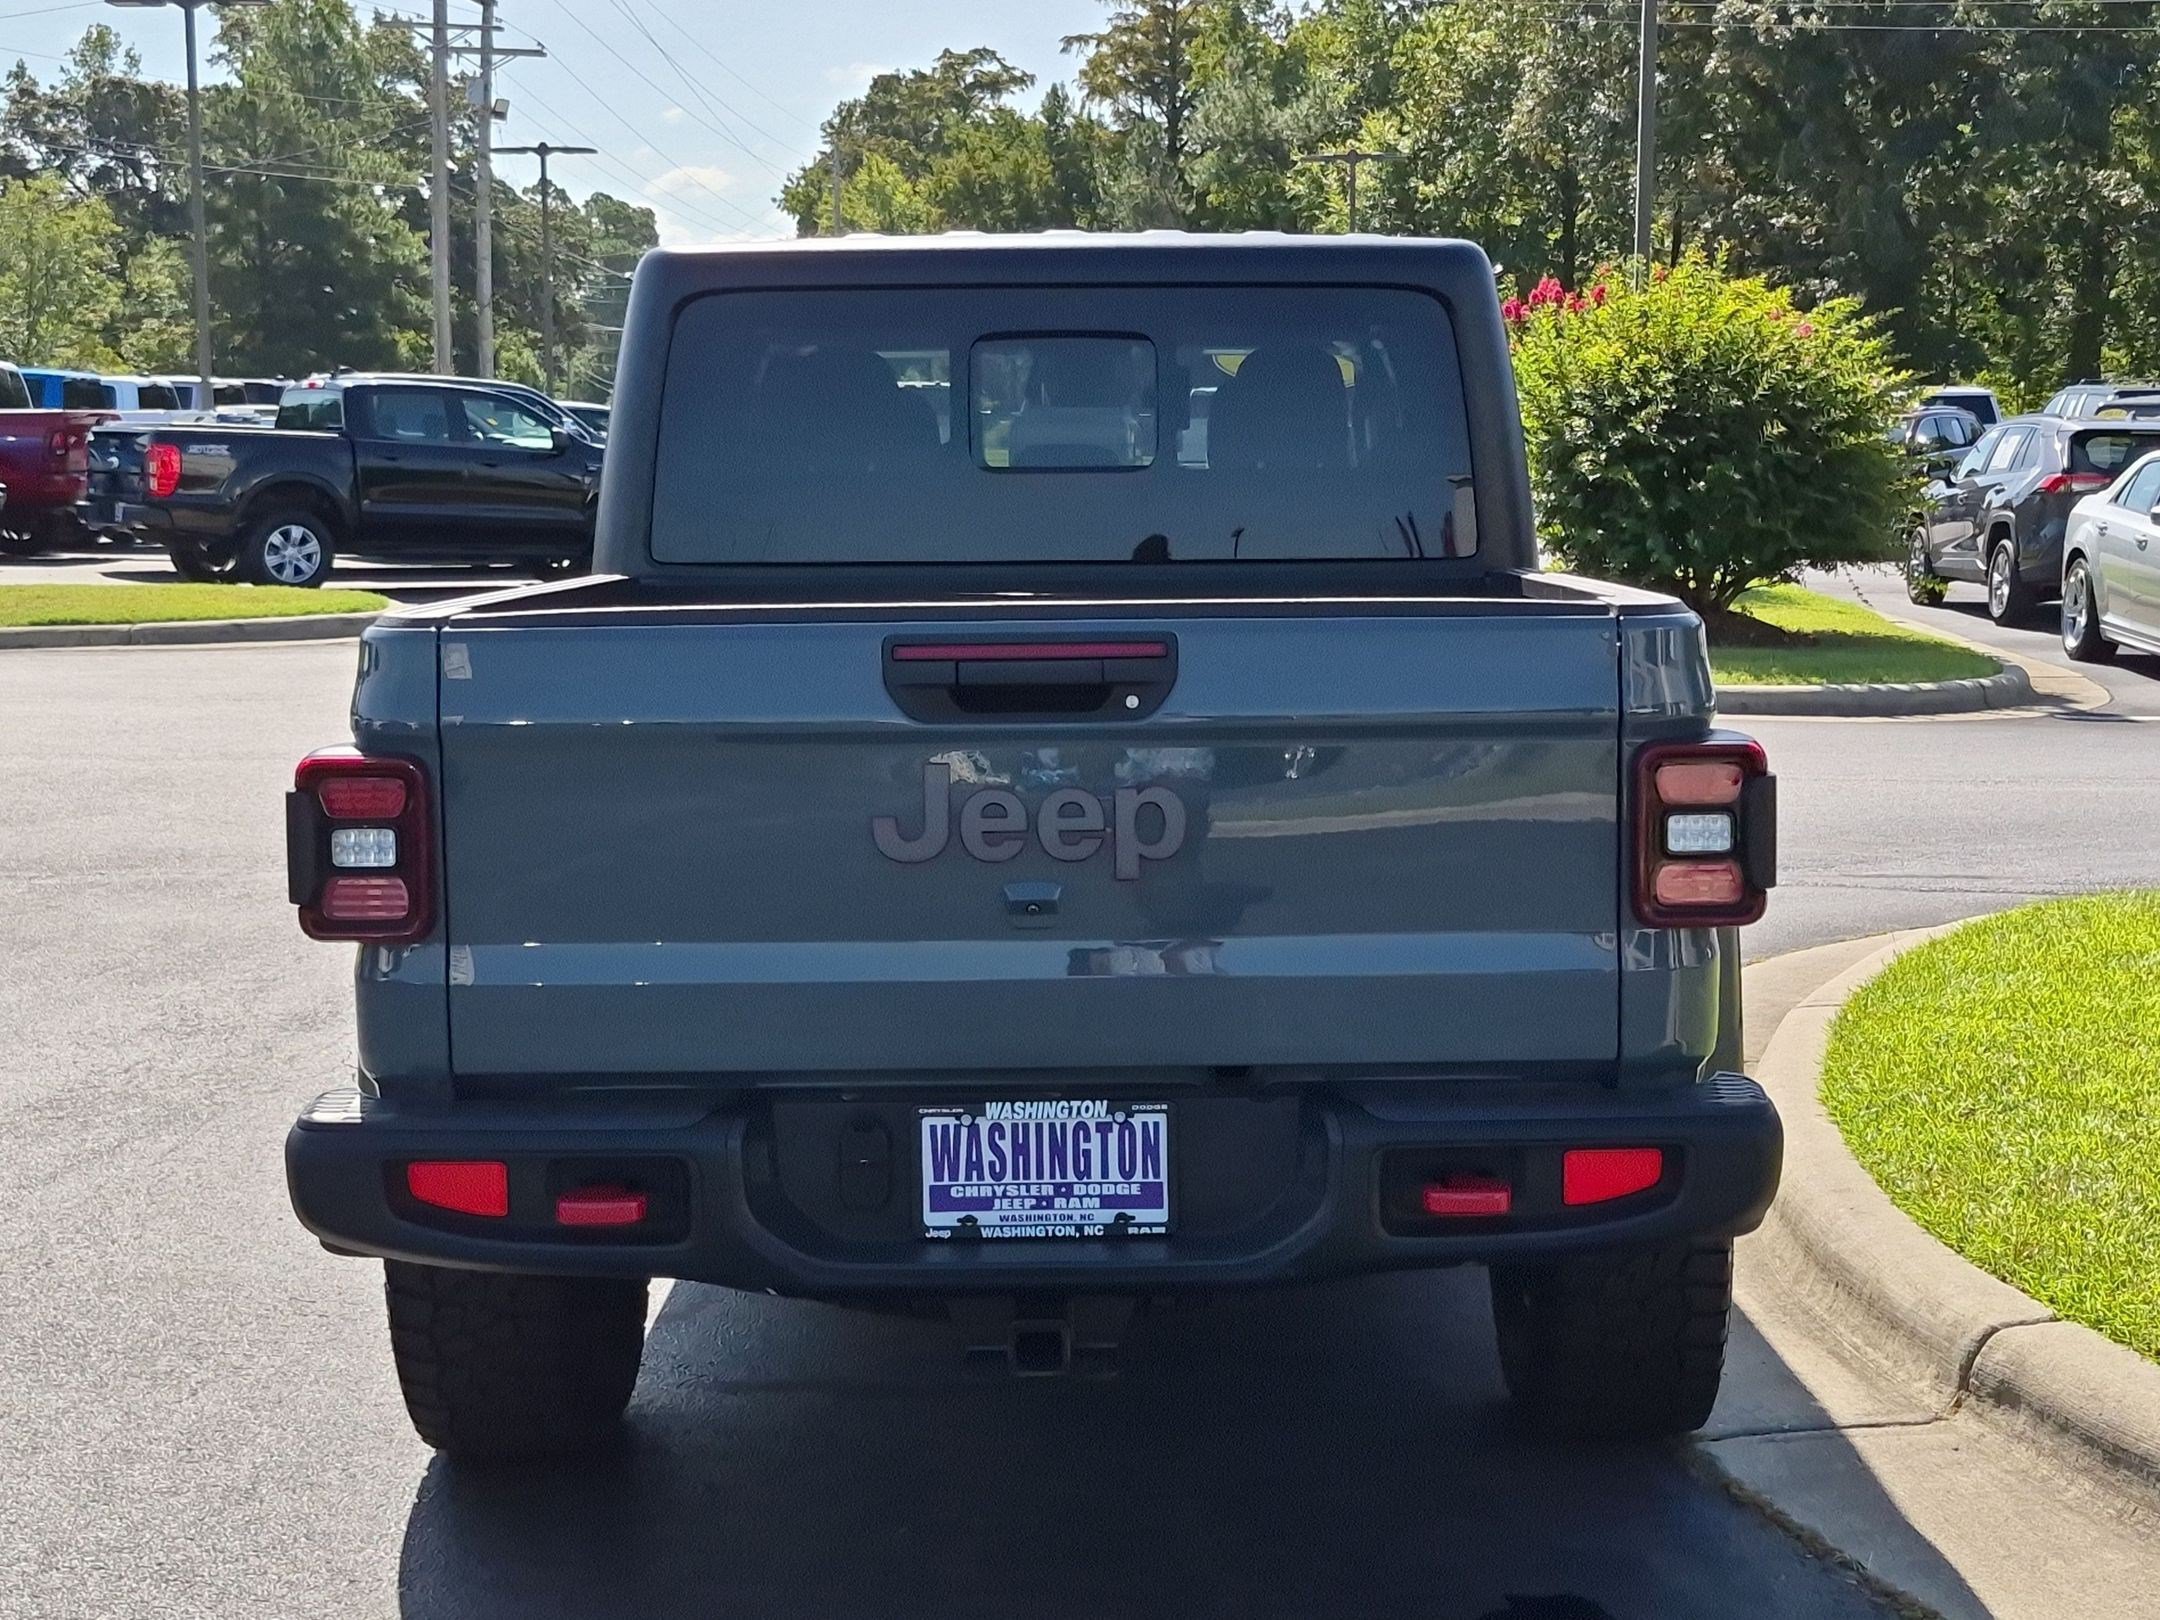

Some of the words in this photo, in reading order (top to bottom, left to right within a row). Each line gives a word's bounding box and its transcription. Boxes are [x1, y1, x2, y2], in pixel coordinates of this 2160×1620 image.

[872, 761, 1186, 880] Jeep
[929, 1121, 1161, 1182] WASHINGTON
[950, 1184, 1054, 1198] CHRYSLER
[1073, 1183, 1141, 1195] DODGE
[992, 1198, 1037, 1210] JEEP
[1054, 1197, 1100, 1209] RAM
[1079, 1213, 1095, 1221] NC
[925, 1228, 951, 1239] Jeep
[980, 1225, 1080, 1238] WASHINGTON,
[1083, 1225, 1104, 1236] NC
[1127, 1226, 1166, 1234] RAM
